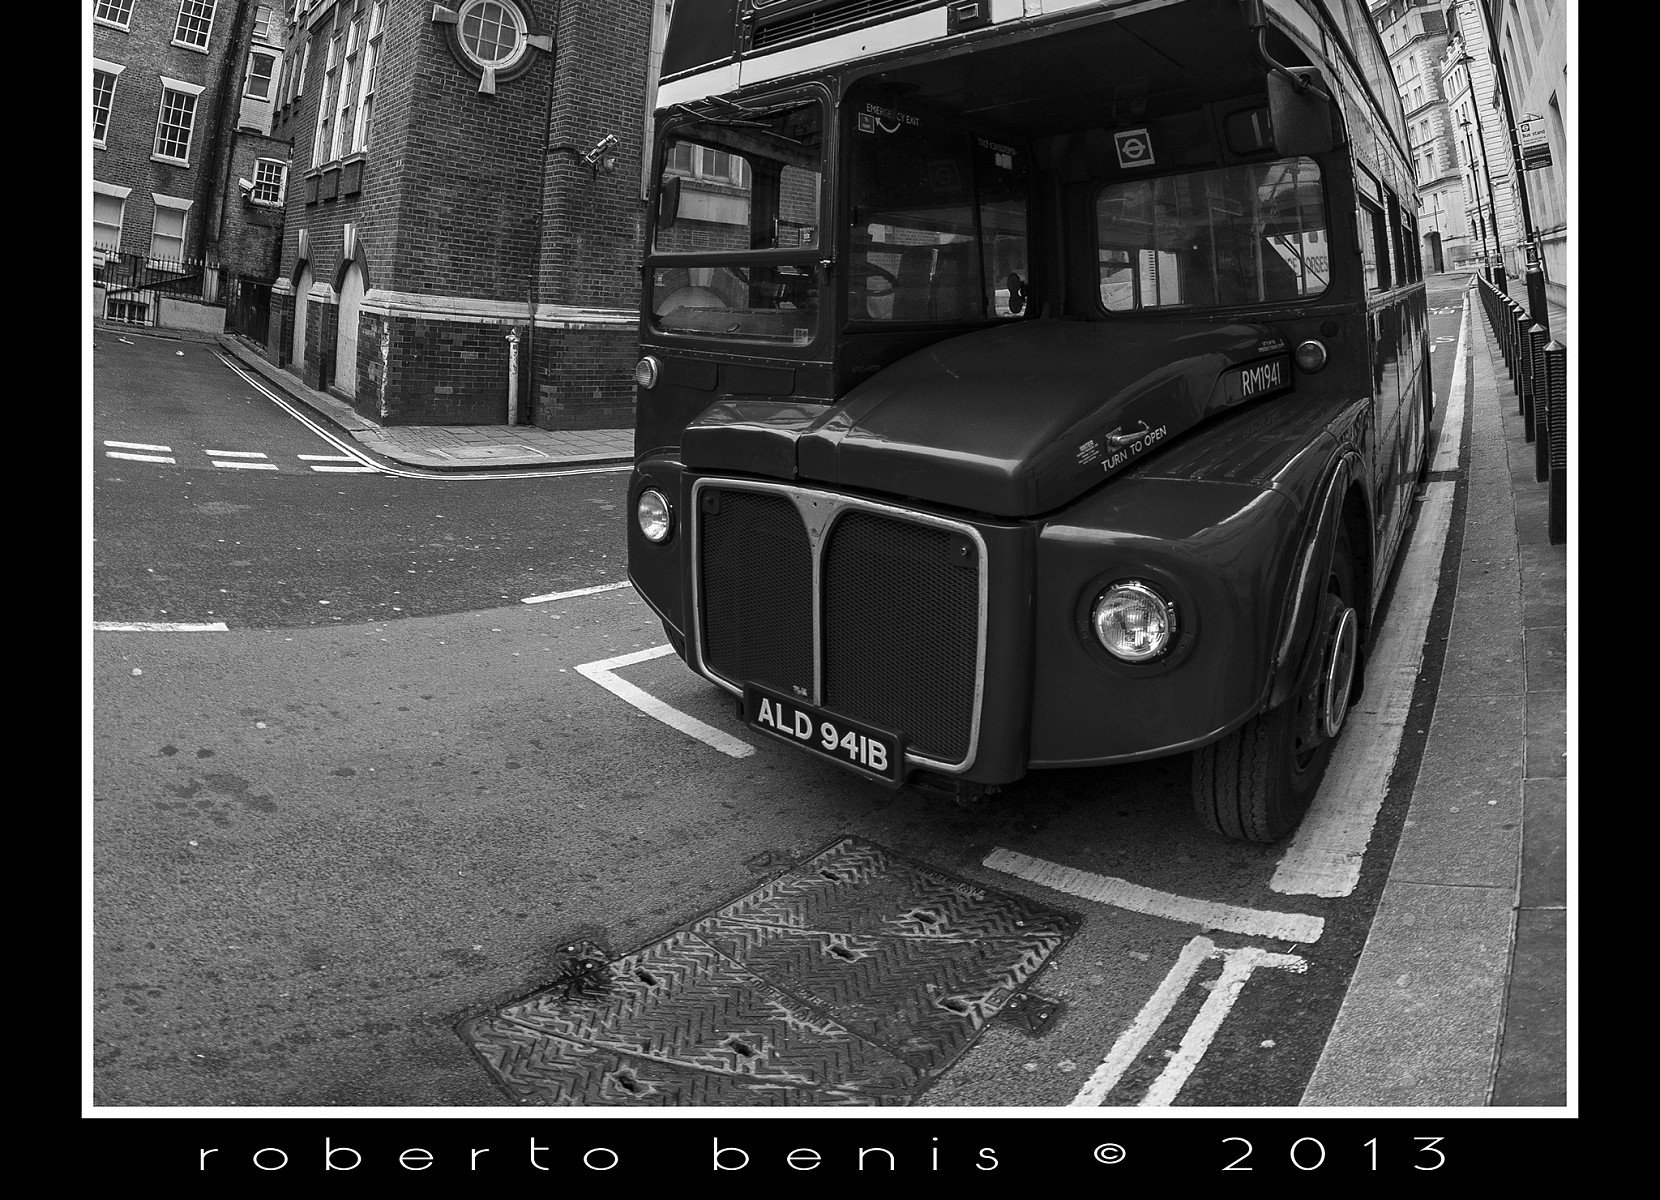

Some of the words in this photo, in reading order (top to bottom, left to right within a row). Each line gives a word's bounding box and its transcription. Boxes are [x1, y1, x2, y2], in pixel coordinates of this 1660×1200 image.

[866, 103, 905, 122] EMERGECY
[906, 115, 920, 127] EXIT
[1241, 361, 1281, 397] RM1941
[1101, 449, 1128, 472] TURN
[1129, 441, 1143, 455] TO
[1143, 425, 1167, 446] OPEN
[757, 697, 813, 740] ALD
[820, 722, 888, 771] 941B
